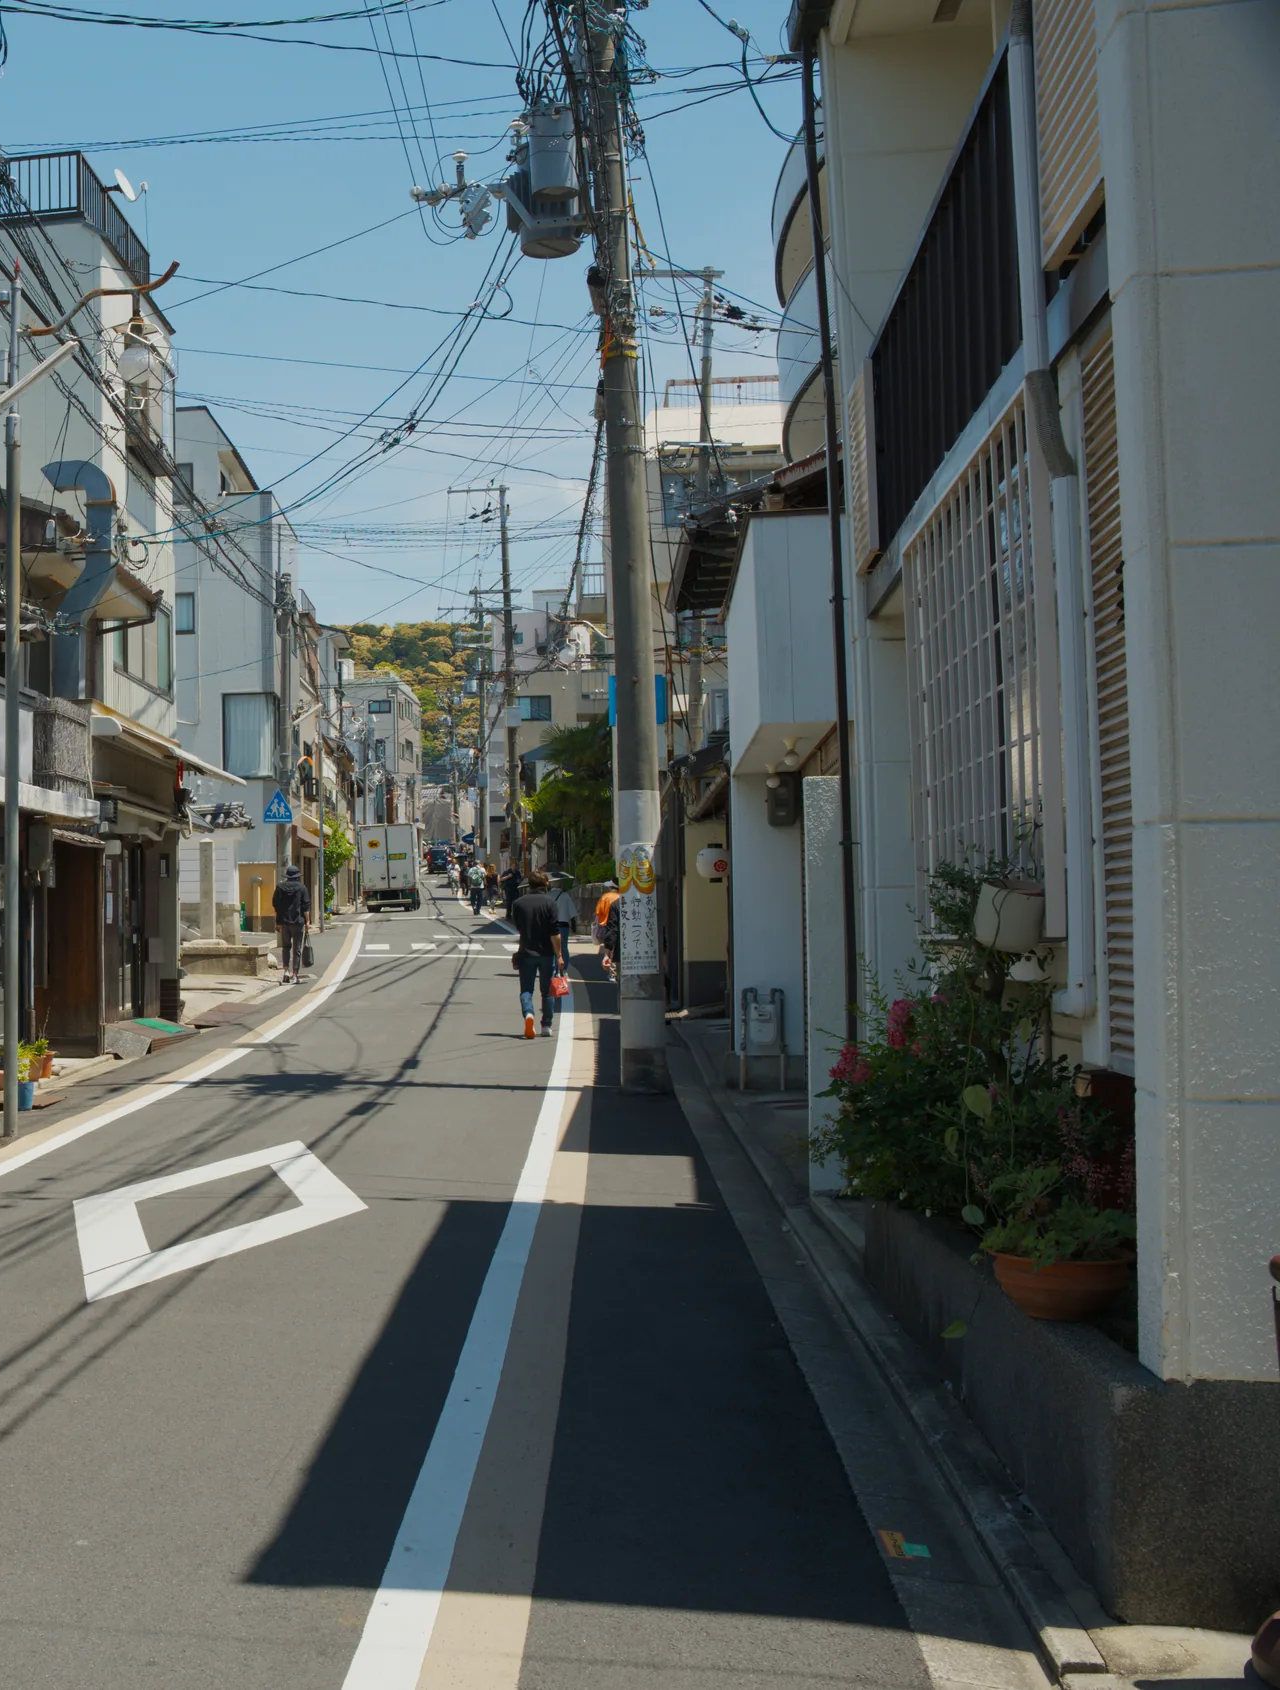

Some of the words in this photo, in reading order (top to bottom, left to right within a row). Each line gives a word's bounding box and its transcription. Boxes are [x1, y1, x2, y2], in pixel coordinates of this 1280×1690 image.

[631, 896, 642, 949] 行動一つで
[645, 895, 656, 948] あぶないよ
